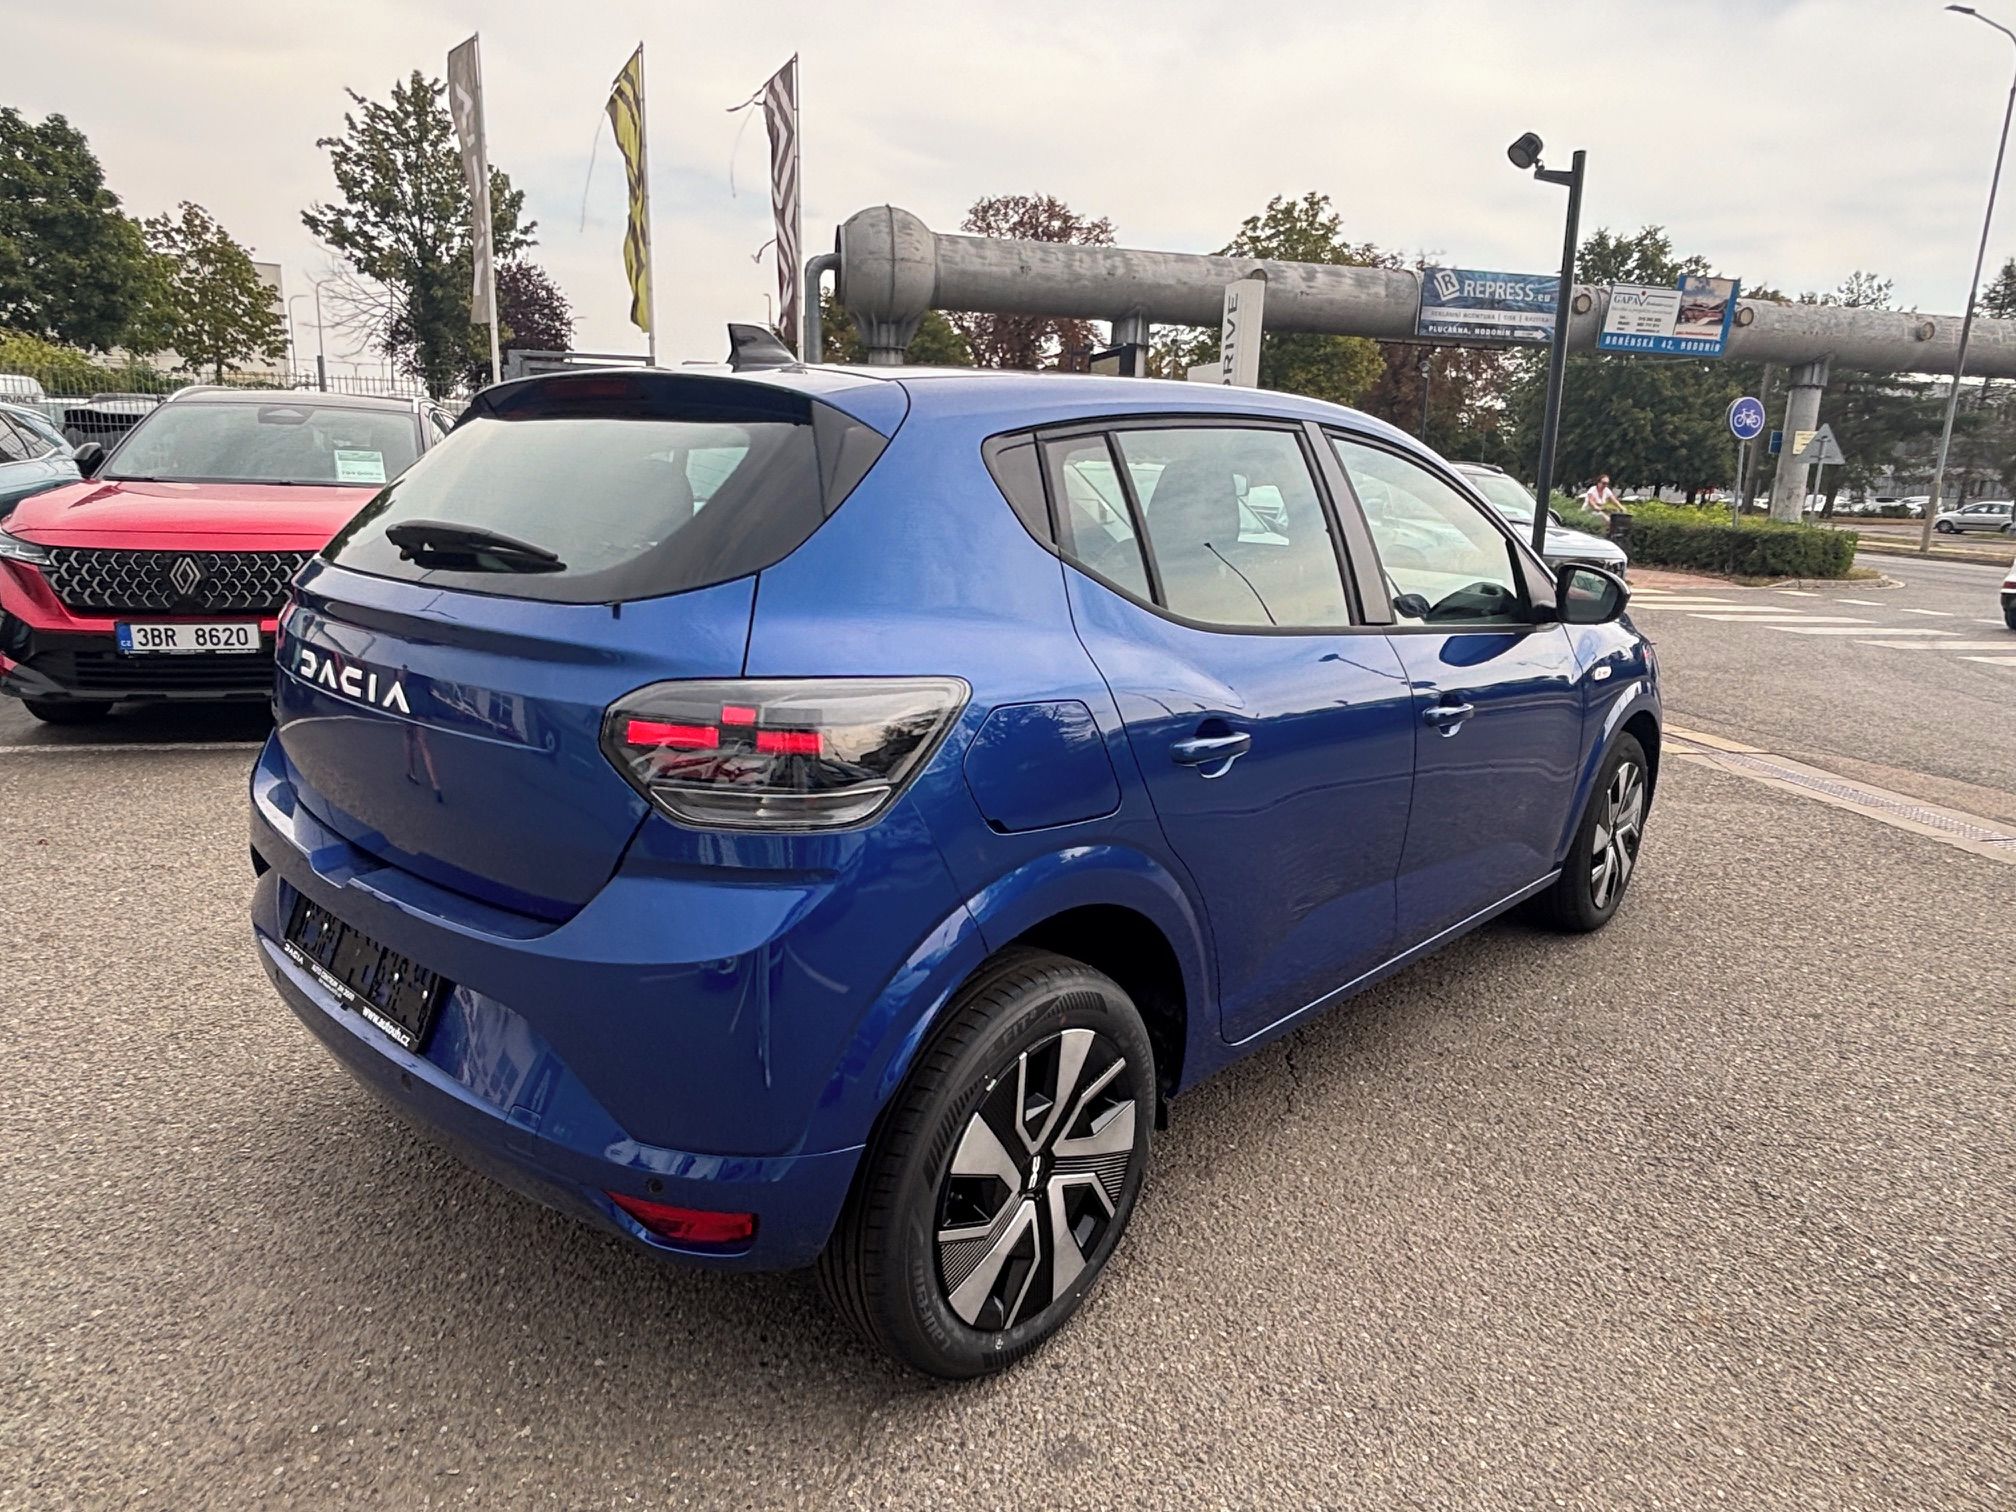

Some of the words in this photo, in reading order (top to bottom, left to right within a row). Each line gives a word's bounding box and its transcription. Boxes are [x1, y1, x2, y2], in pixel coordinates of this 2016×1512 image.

[1464, 280, 1551, 302] REPRESS.eu
[136, 627, 177, 647] 3BR
[194, 627, 249, 647] 8620
[300, 649, 410, 714] DACIA
[284, 942, 304, 965] DACIA
